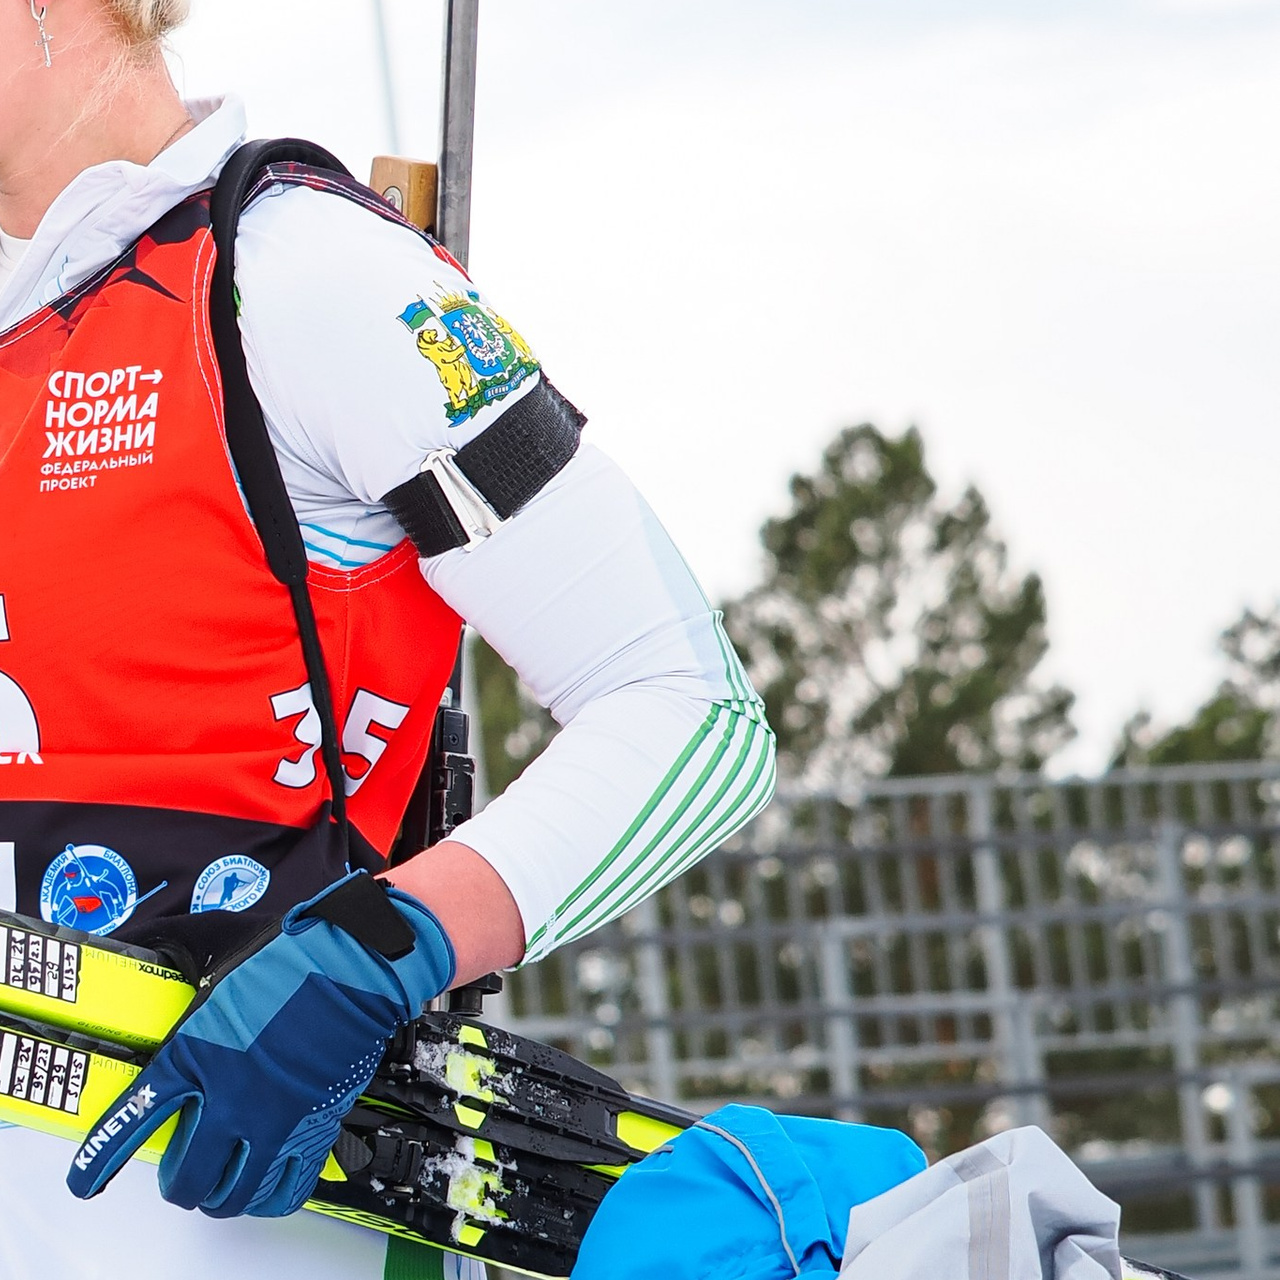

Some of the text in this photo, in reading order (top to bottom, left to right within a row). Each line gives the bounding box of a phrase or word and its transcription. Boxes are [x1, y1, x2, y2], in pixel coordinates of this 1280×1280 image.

[47, 365, 142, 399] СПОРТ
[45, 392, 159, 428] НОРМА
[42, 421, 156, 459] ЖИЗНИ
[40, 449, 153, 476] ФЕДЕРАЛЬНЫЙ
[40, 475, 97, 493] ПРОЕКТ
[269, 681, 410, 797] 35
[42, 849, 136, 903] АКАДЕМИЯ БИАТЛОНА
[198, 863, 221, 890] СОЮЗ
